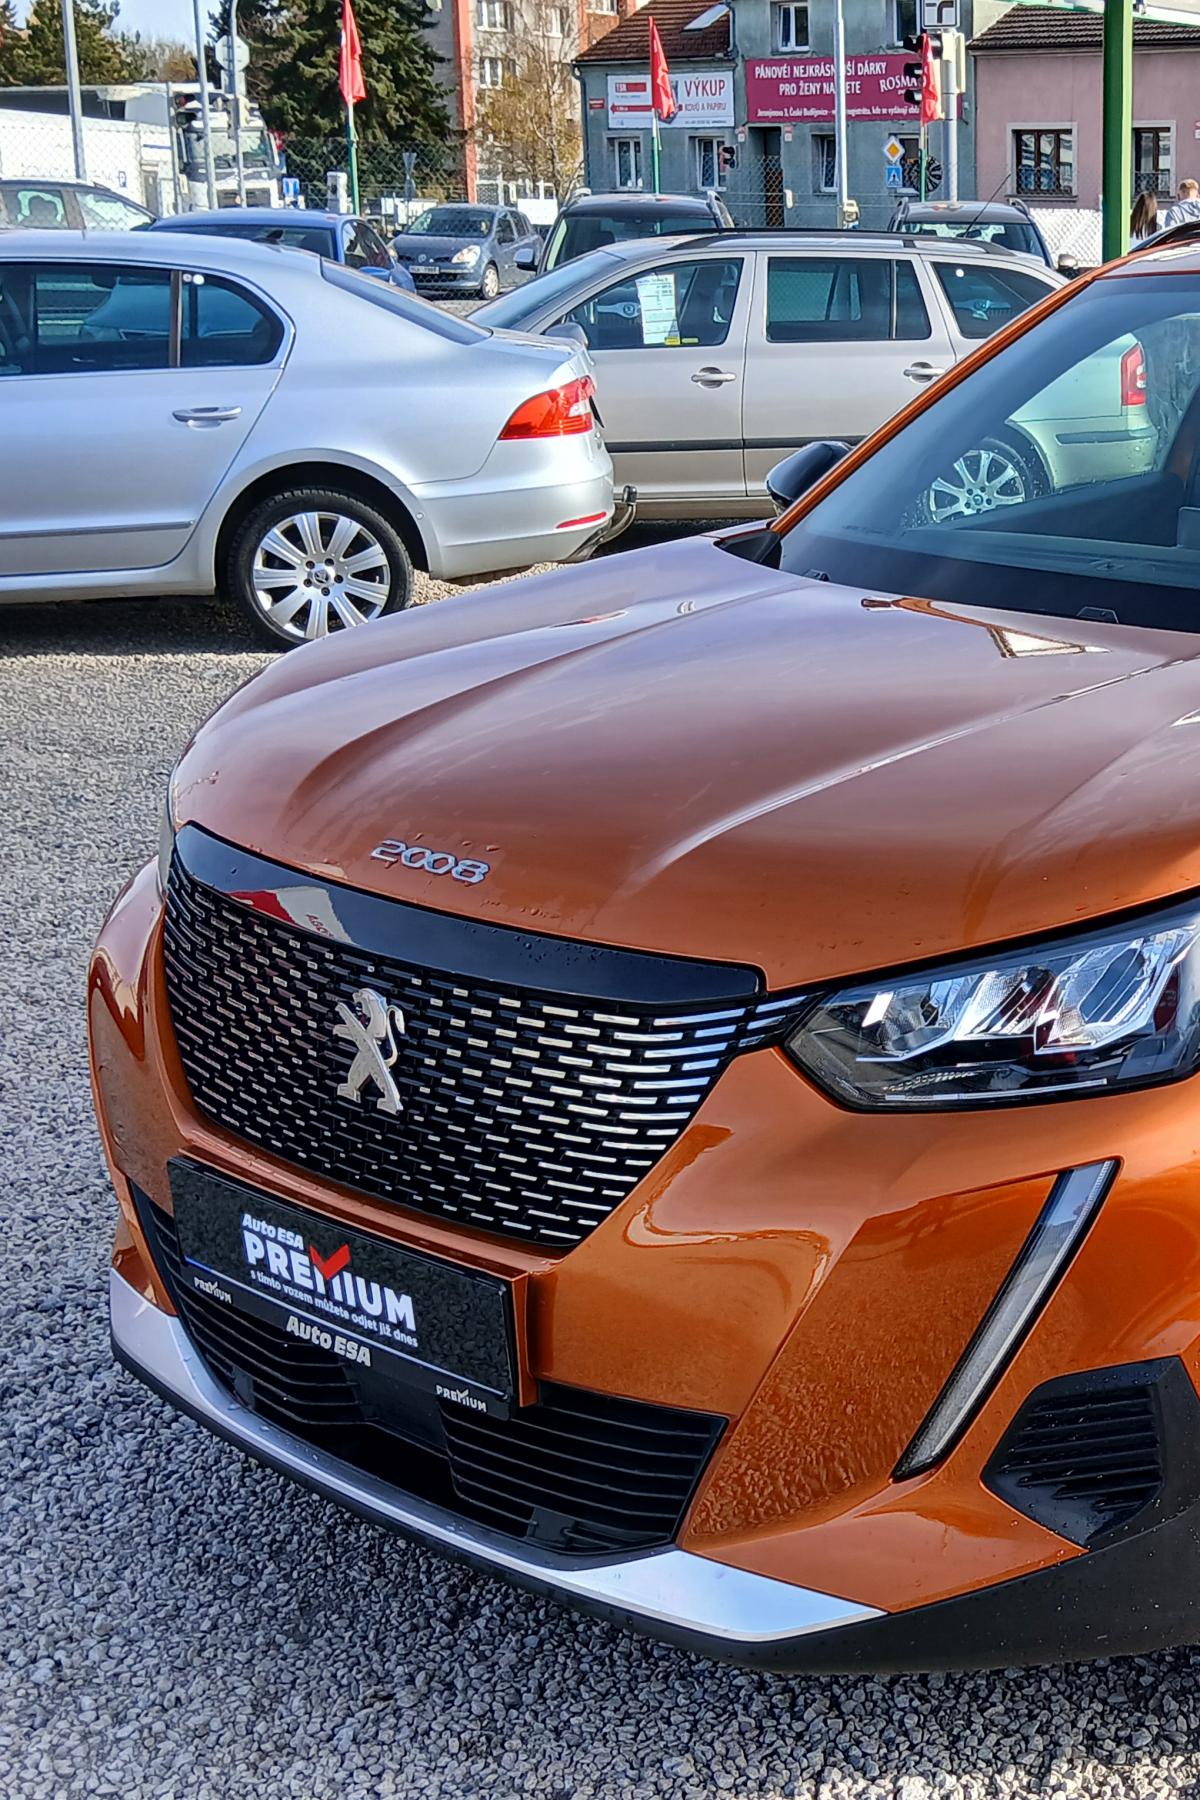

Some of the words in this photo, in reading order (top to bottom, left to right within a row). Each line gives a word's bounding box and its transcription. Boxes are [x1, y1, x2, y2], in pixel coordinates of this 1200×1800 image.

[754, 63, 790, 79] PÁNOVÉ!
[793, 60, 856, 78] NEJKRÁSNŠÍ
[857, 59, 887, 76] DÁRKY
[684, 76, 726, 98] VÝKUP
[779, 83, 797, 96] PRO
[799, 80, 821, 96] ŽENY
[823, 80, 862, 95] NAETE
[370, 838, 491, 884] 2008
[242, 1213, 277, 1238] Auto
[277, 1226, 305, 1250] ESA
[194, 1276, 232, 1304] PREMIUM
[243, 1230, 417, 1332] PREMIUM
[250, 1269, 256, 1279] s
[282, 1284, 313, 1305] vozem
[314, 1296, 350, 1320] můžete
[351, 1313, 378, 1332] odjet
[393, 1329, 419, 1348] dnes
[285, 1315, 333, 1350] Auto
[333, 1335, 372, 1367] ESA
[435, 1384, 488, 1413] PREMIUM
